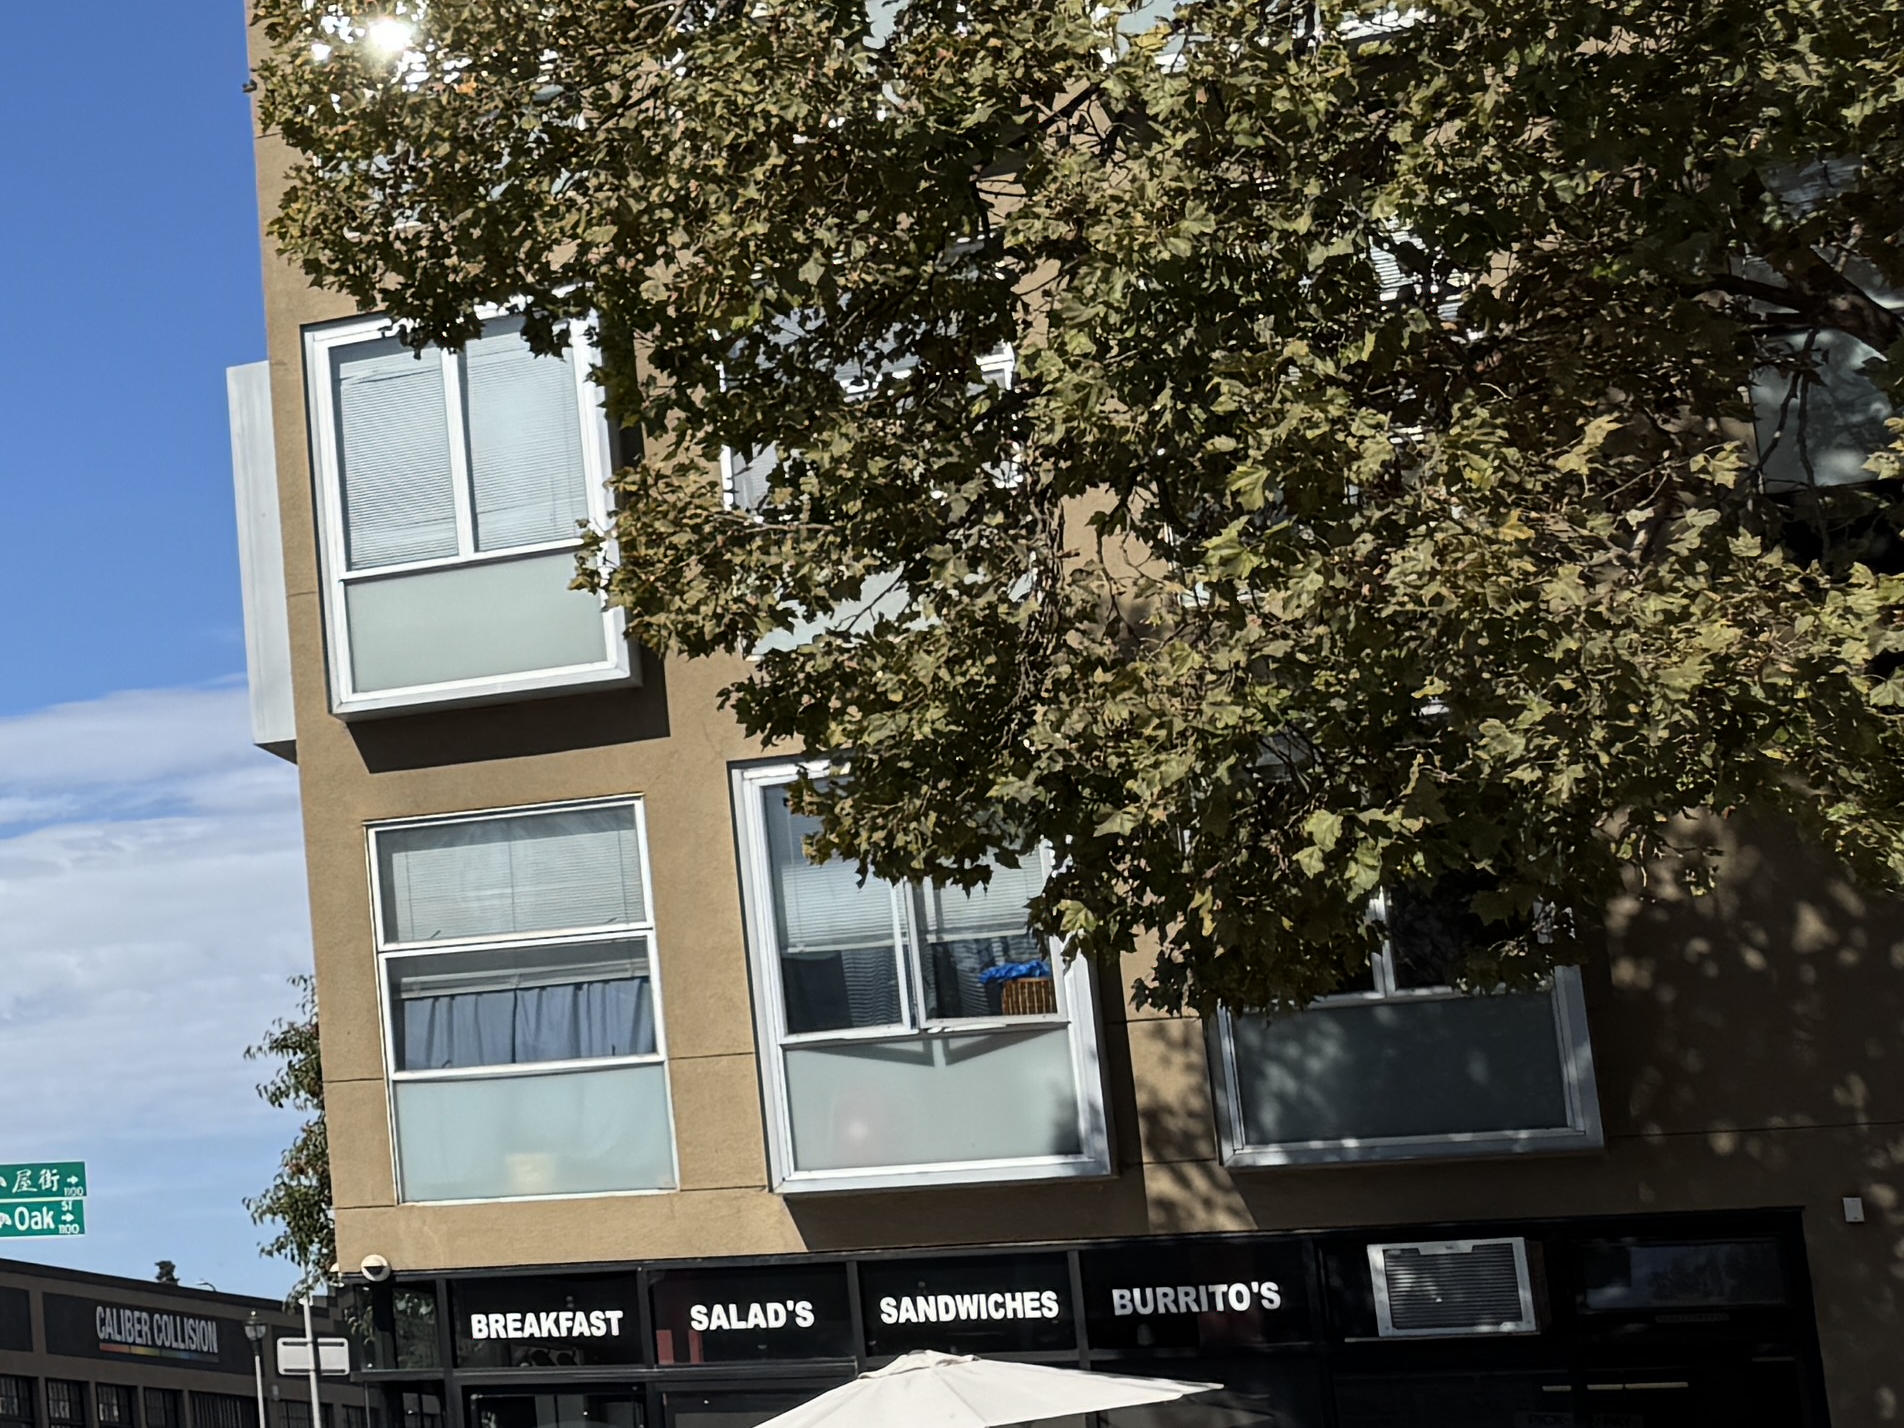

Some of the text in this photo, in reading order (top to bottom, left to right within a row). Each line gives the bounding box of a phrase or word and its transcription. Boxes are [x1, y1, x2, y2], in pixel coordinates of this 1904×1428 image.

[14, 1206, 55, 1231] Oak
[879, 1290, 1060, 1324] SANDWICHES
[1112, 1282, 1282, 1316] BURRITO'S
[96, 1306, 218, 1353] CALIBER COLLISION
[471, 1310, 623, 1340] BREAKFAST
[690, 1301, 815, 1331] SALAD'S
